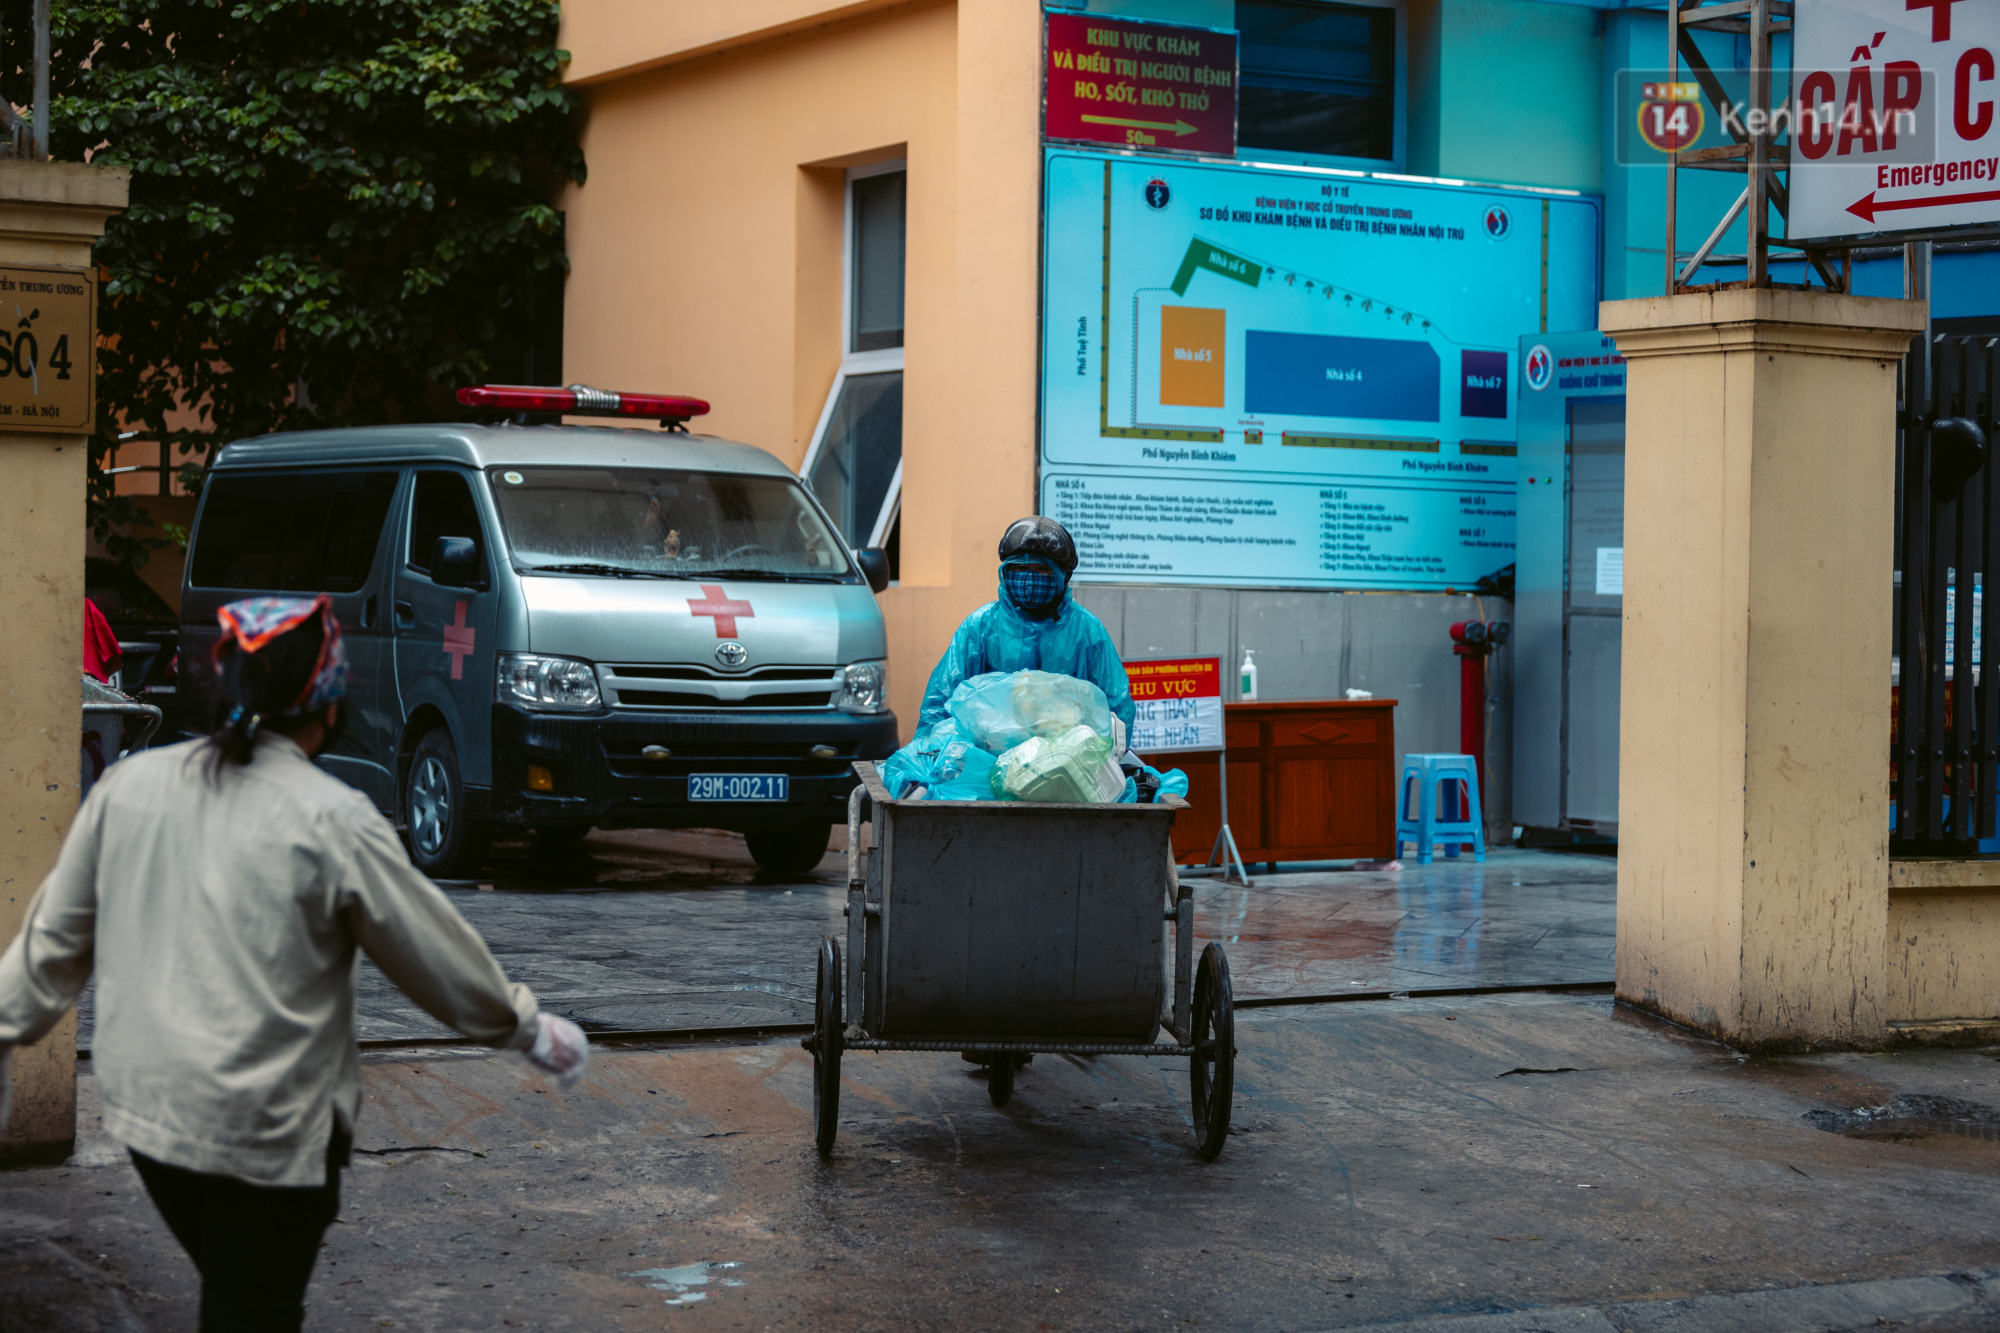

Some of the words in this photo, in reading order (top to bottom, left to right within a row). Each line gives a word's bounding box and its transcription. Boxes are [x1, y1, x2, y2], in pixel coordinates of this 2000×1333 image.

[1087, 28, 1119, 48] KHU
[1123, 32, 1153, 53] VỰC
[1157, 35, 1200, 57] KHÁM
[1053, 48, 1074, 70] VÀ
[1114, 58, 1137, 79] TRỊ
[1141, 61, 1190, 82] NGƯỜI
[1194, 65, 1231, 88] BỆNH
[1075, 81, 1102, 101] HO,
[1105, 81, 1137, 105] SỐT,
[1141, 88, 1175, 107] KHÓ
[1178, 89, 1210, 111] THỞ
[1798, 31, 1922, 160] CẤP
[1953, 47, 2000, 141] C
[1126, 129, 1155, 145] 50m
[1877, 156, 1999, 189] Emergency
[1334, 187, 1338, 196] Y
[1298, 200, 1302, 210] Y
[1366, 206, 1390, 218] TRUNG
[1200, 207, 1213, 220] SƠ
[1232, 210, 1252, 223] KHU
[1286, 213, 1312, 229] BỆNH
[1315, 215, 1327, 229] VÀ
[1354, 220, 1369, 235] TRỊ
[1372, 220, 1396, 237] BỆNH
[1399, 222, 1425, 238] NHÂN
[1428, 224, 1444, 241] NỘI
[1209, 251, 1227, 267] Nhà
[1228, 259, 1240, 272] số
[1240, 262, 1247, 274] 6
[19, 282, 54, 294] TRUNG
[57, 283, 84, 296] ƯƠNG
[49, 334, 72, 380] 4
[1174, 348, 1193, 361] Nhà
[1194, 348, 1205, 361] số
[1206, 350, 1212, 362] 5
[1326, 368, 1343, 380] Nhà
[1345, 368, 1356, 381] số
[1356, 370, 1362, 382] 4
[1467, 375, 1484, 388] Nhà
[1485, 376, 1495, 389] số
[1496, 378, 1501, 389] 7
[1142, 448, 1158, 458] Phố
[1159, 448, 1189, 462] Nguyễn
[1211, 450, 1236, 462] Khiêm
[1402, 459, 1417, 470] Phố
[1162, 679, 1196, 696] VỰC
[1164, 723, 1200, 746] NHÂN
[691, 777, 783, 798] 29M-002.11
